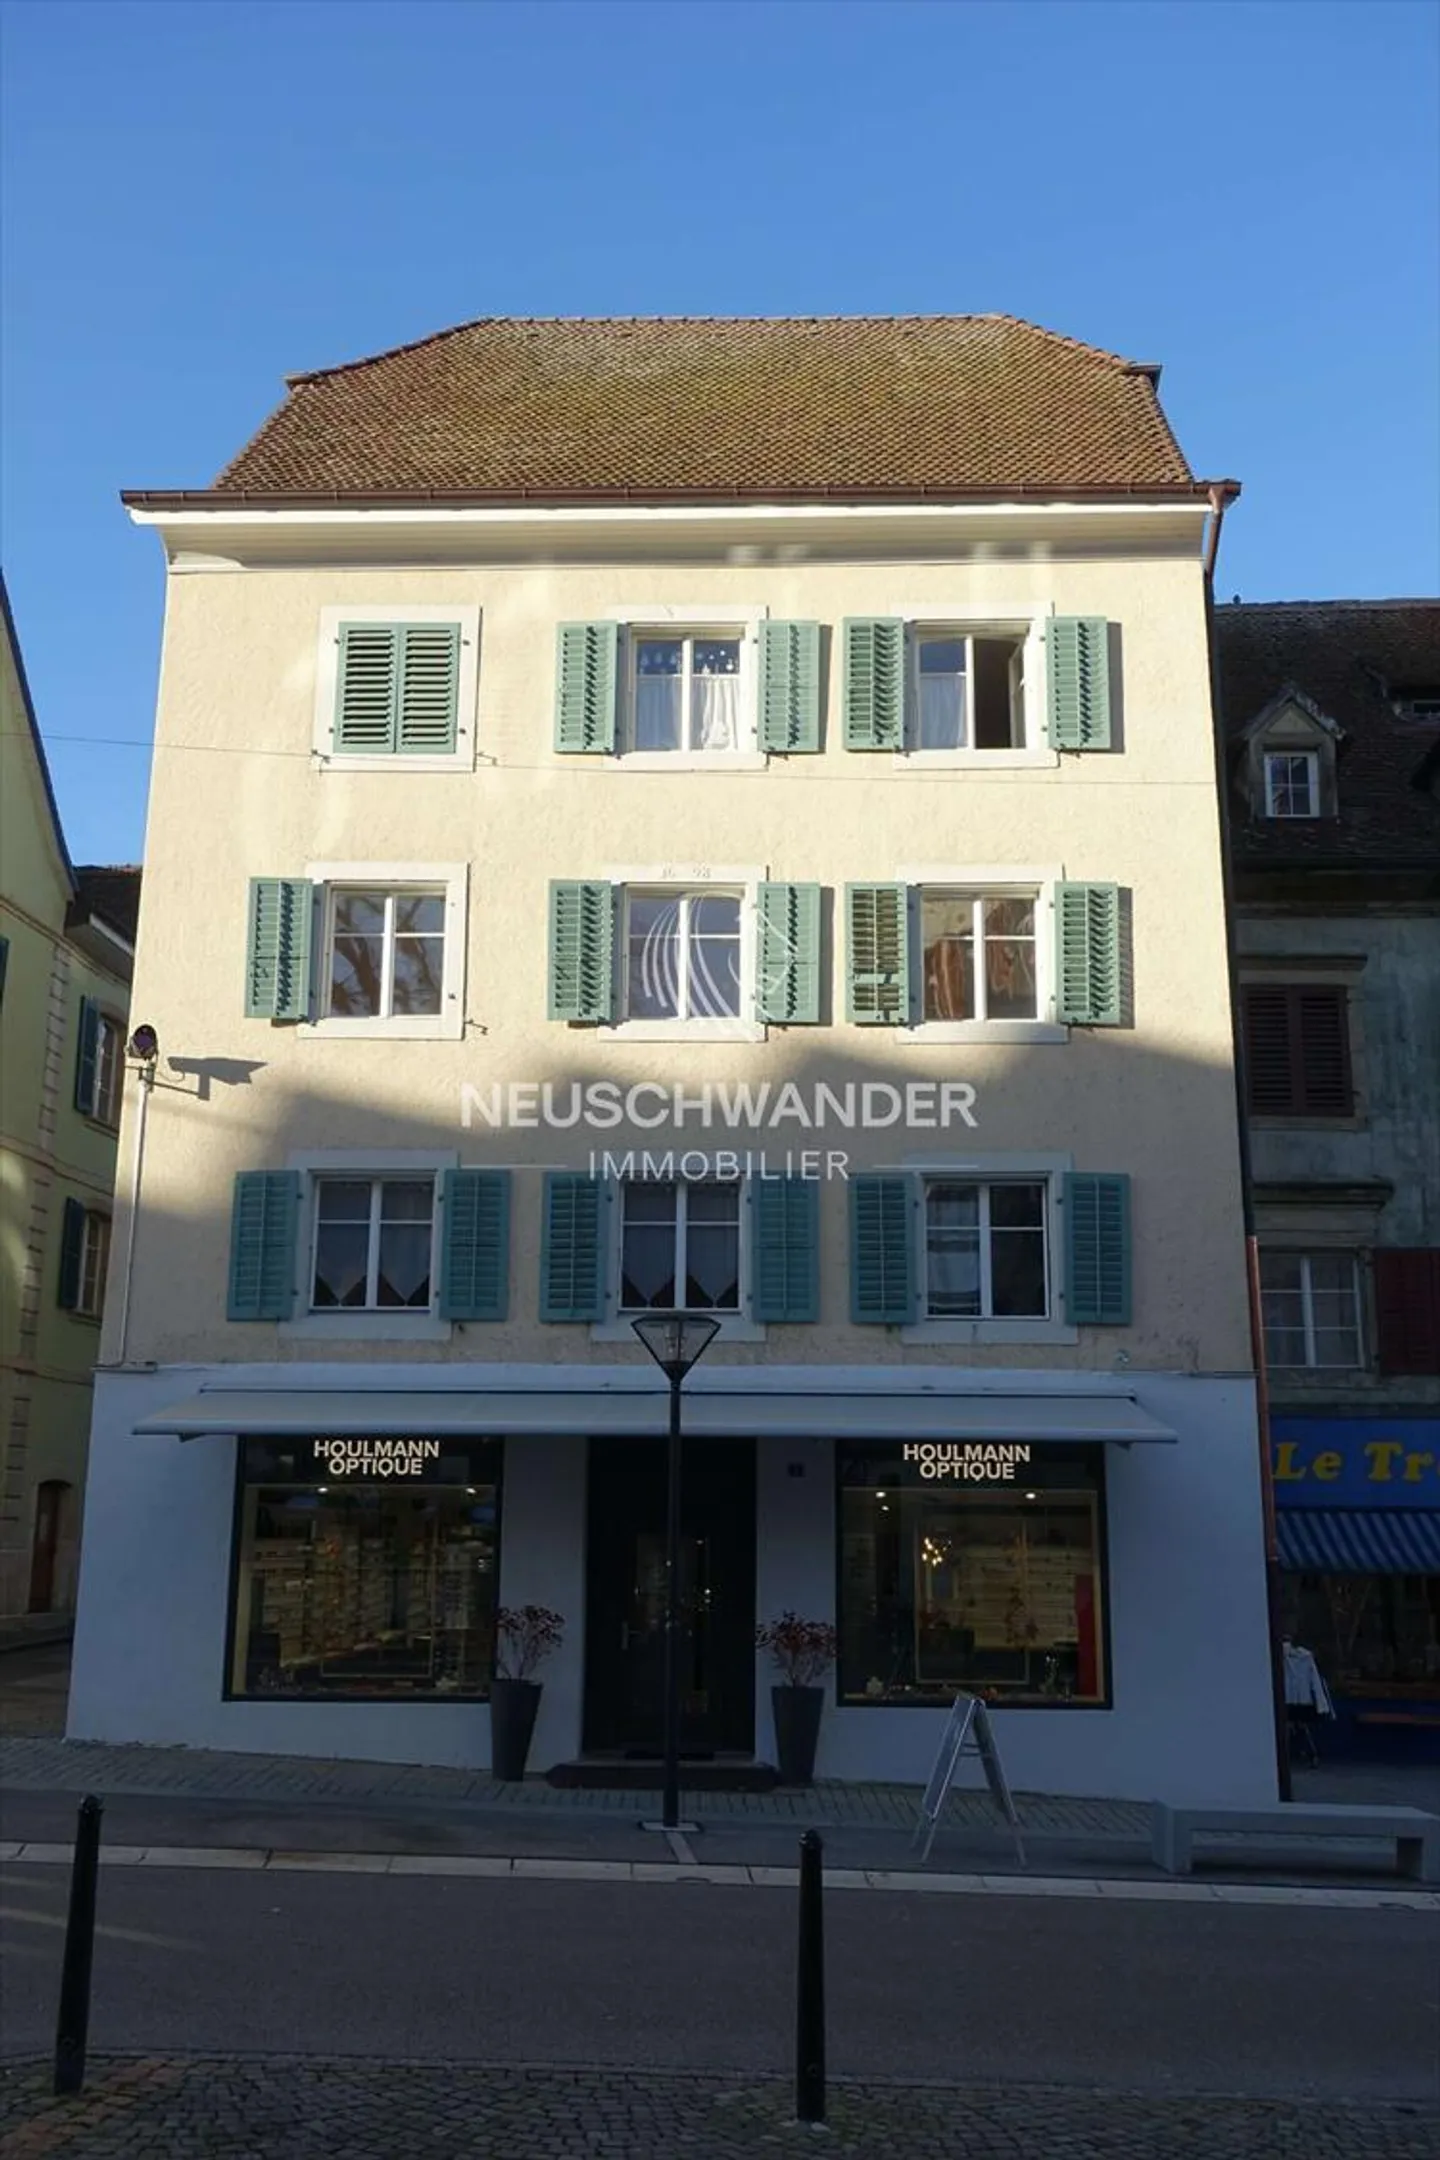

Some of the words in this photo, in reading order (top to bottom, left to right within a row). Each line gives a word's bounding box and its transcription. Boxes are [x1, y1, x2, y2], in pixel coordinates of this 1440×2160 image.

[313, 1440, 440, 1457] HOULMANN
[903, 1443, 1031, 1462] HOULMANN
[329, 1457, 422, 1477] OPTIQUE
[919, 1461, 1015, 1481] OPTIQUE
[1273, 1441, 1342, 1480] Le
[1364, 1441, 1440, 1481] Tr
